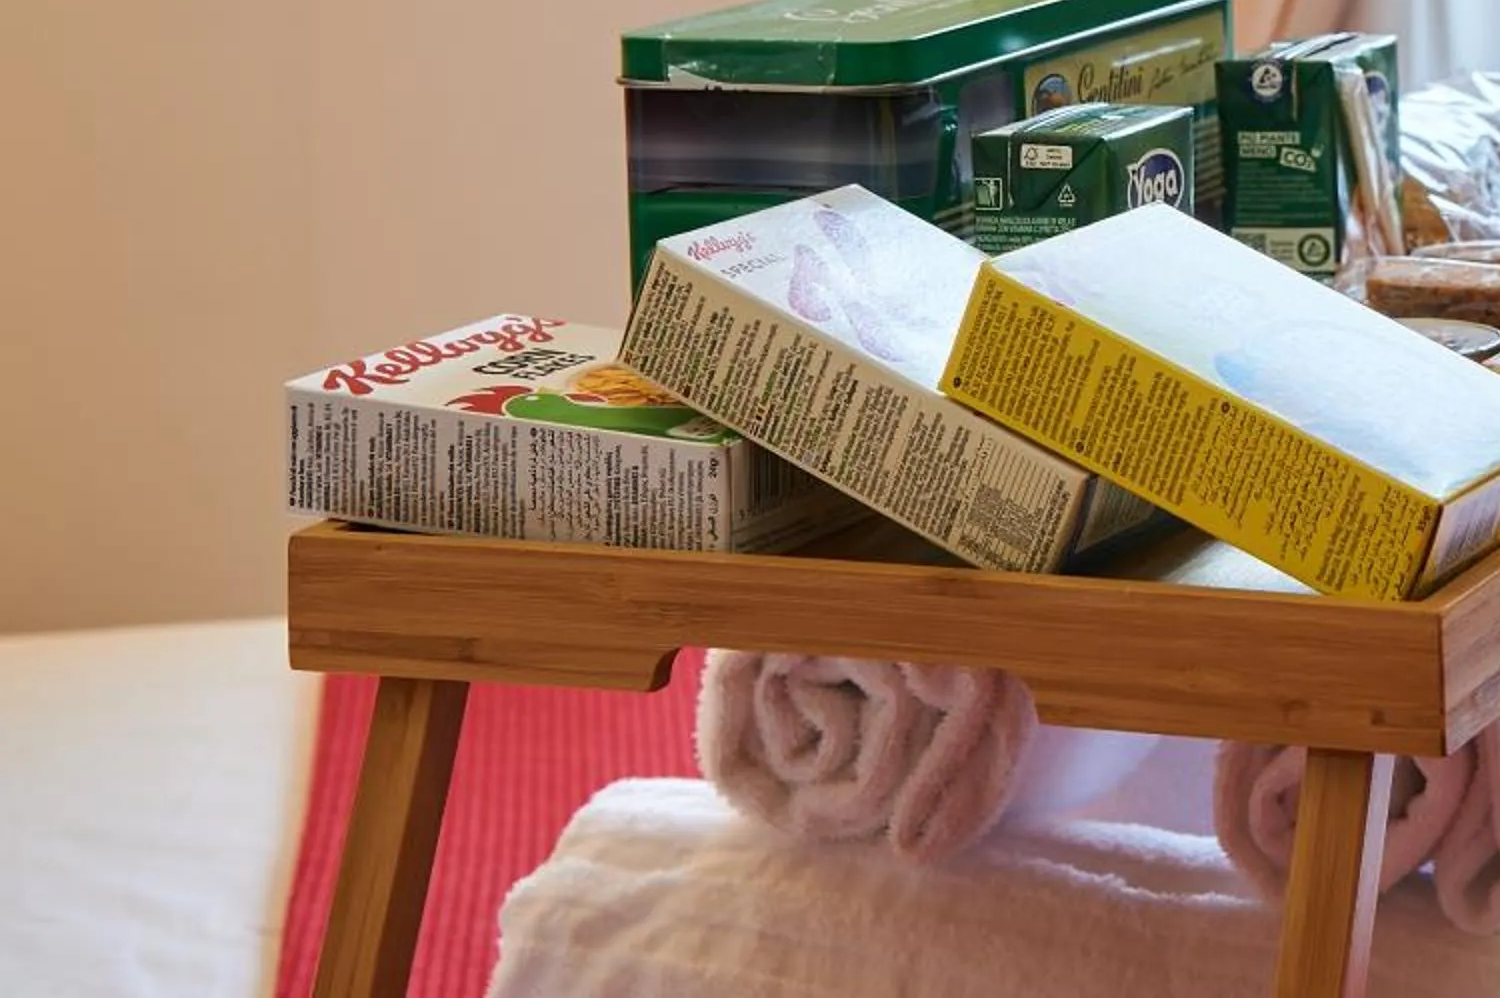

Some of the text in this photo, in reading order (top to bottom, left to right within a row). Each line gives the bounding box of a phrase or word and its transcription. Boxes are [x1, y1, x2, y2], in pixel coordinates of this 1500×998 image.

[1133, 165, 1178, 207] Yoga
[687, 231, 757, 262] Kellogg's
[720, 252, 787, 279] SPECIAL
[322, 315, 567, 395] Kellogg's
[472, 347, 567, 375] CORN
[511, 353, 596, 381] FLAKES
